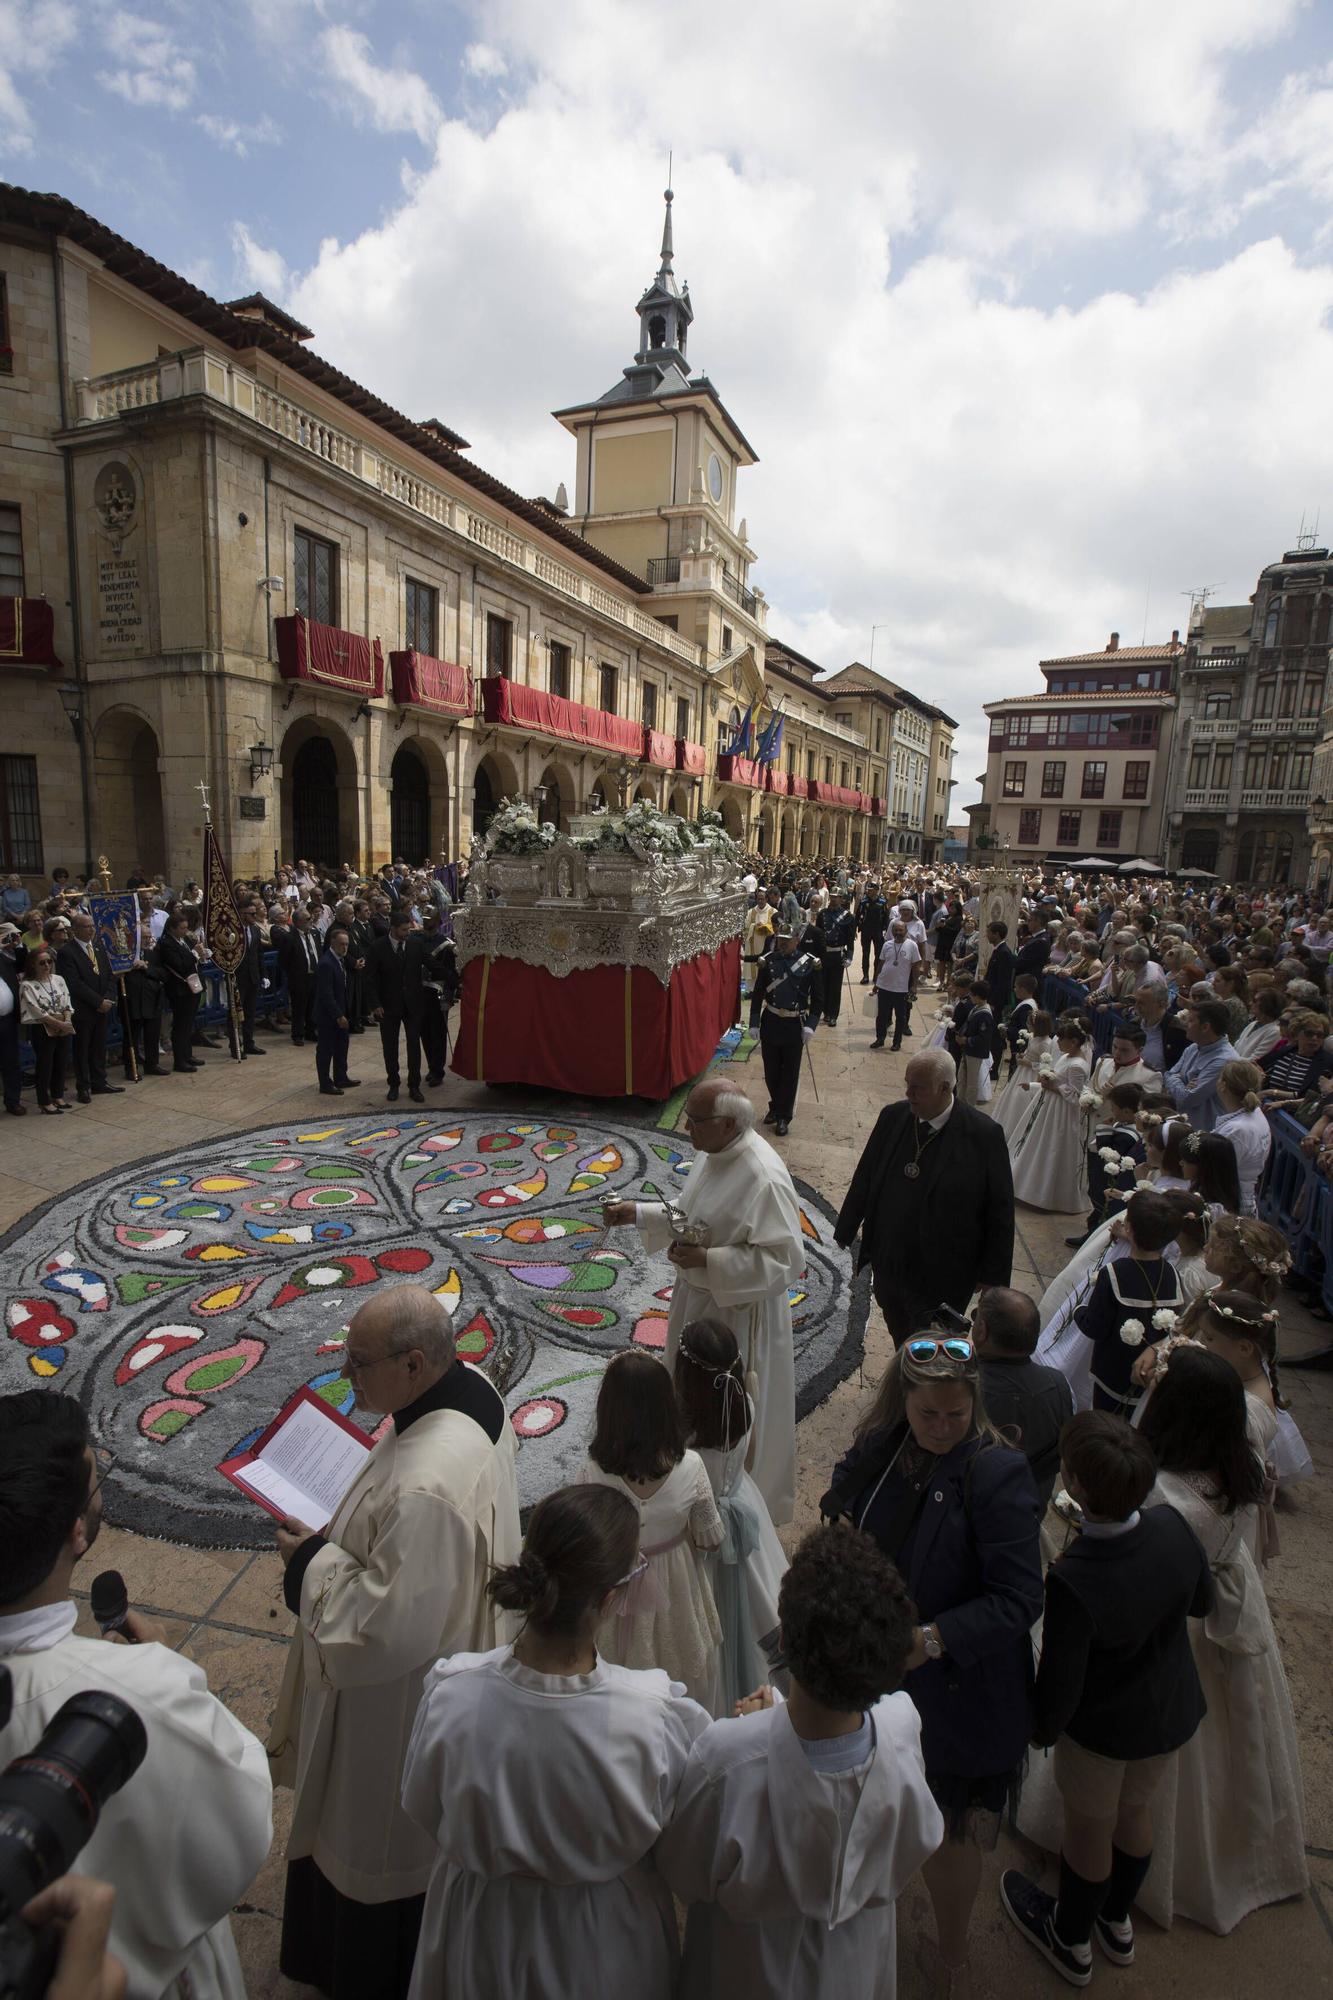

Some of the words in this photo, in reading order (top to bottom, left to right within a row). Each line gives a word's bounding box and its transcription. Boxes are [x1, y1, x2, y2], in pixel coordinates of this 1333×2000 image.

[114, 560, 136, 569] NOBLE
[118, 570, 138, 579] LEAL
[100, 580, 140, 592] BENEMERITA
[105, 592, 135, 602] INVICTA
[107, 633, 136, 643] OVIEDO
